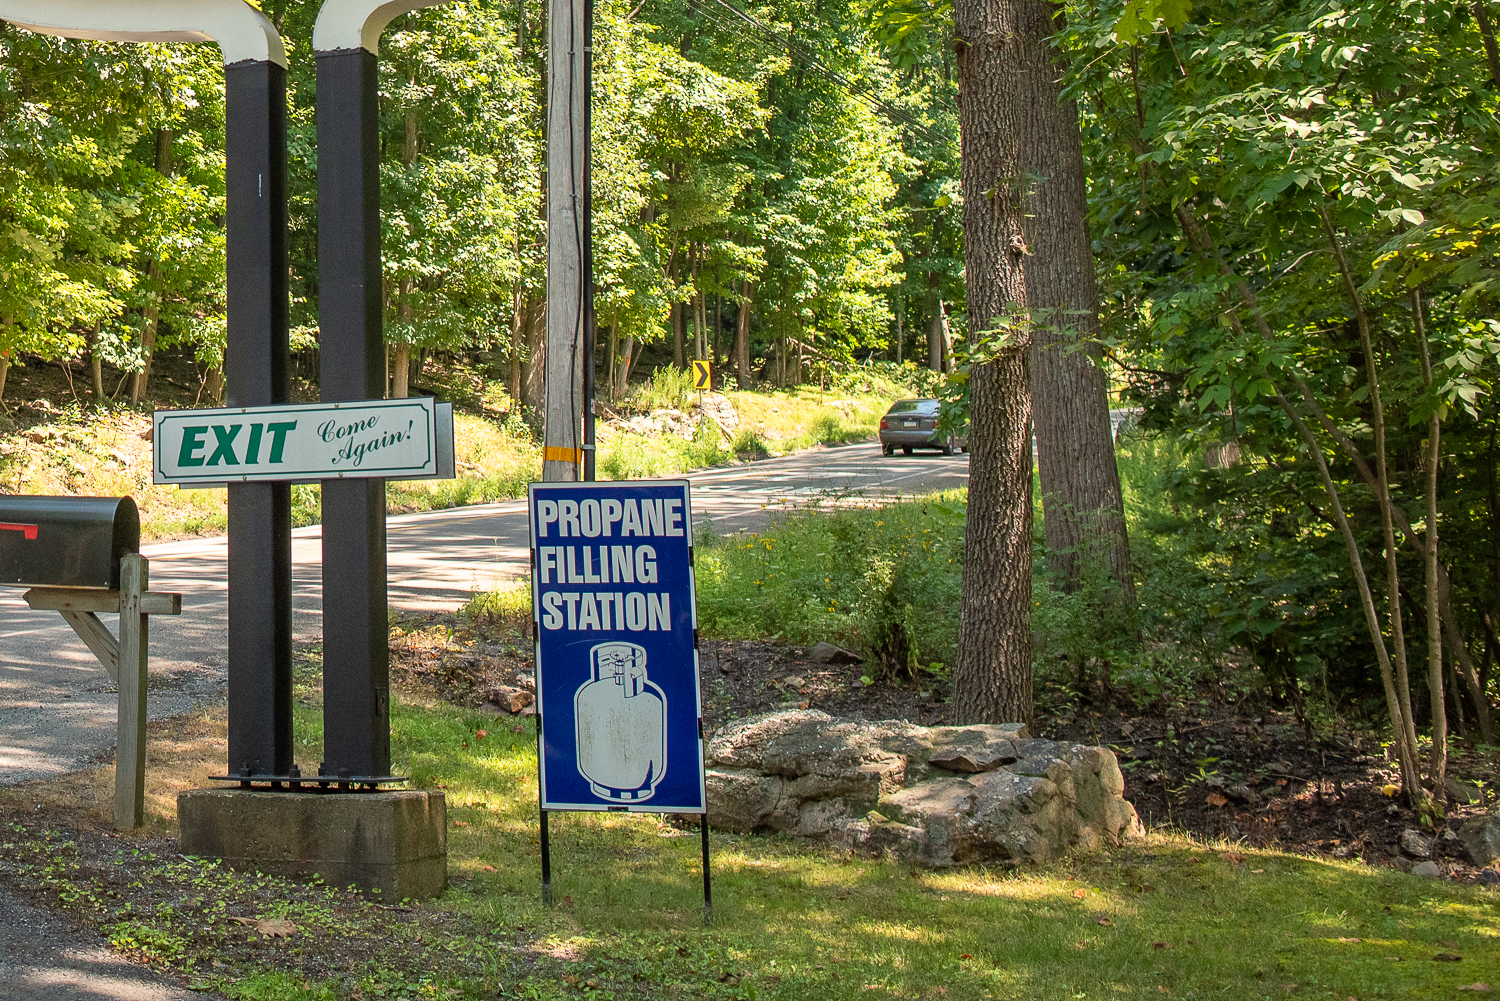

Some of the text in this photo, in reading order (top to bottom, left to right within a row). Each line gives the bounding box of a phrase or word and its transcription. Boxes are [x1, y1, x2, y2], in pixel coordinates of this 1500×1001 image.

[176, 419, 298, 468] EXIT
[317, 415, 380, 443] Come
[331, 419, 414, 467] Again!
[537, 498, 684, 538] PROPANE
[539, 545, 658, 584] FILLING
[541, 591, 672, 632] STATION
